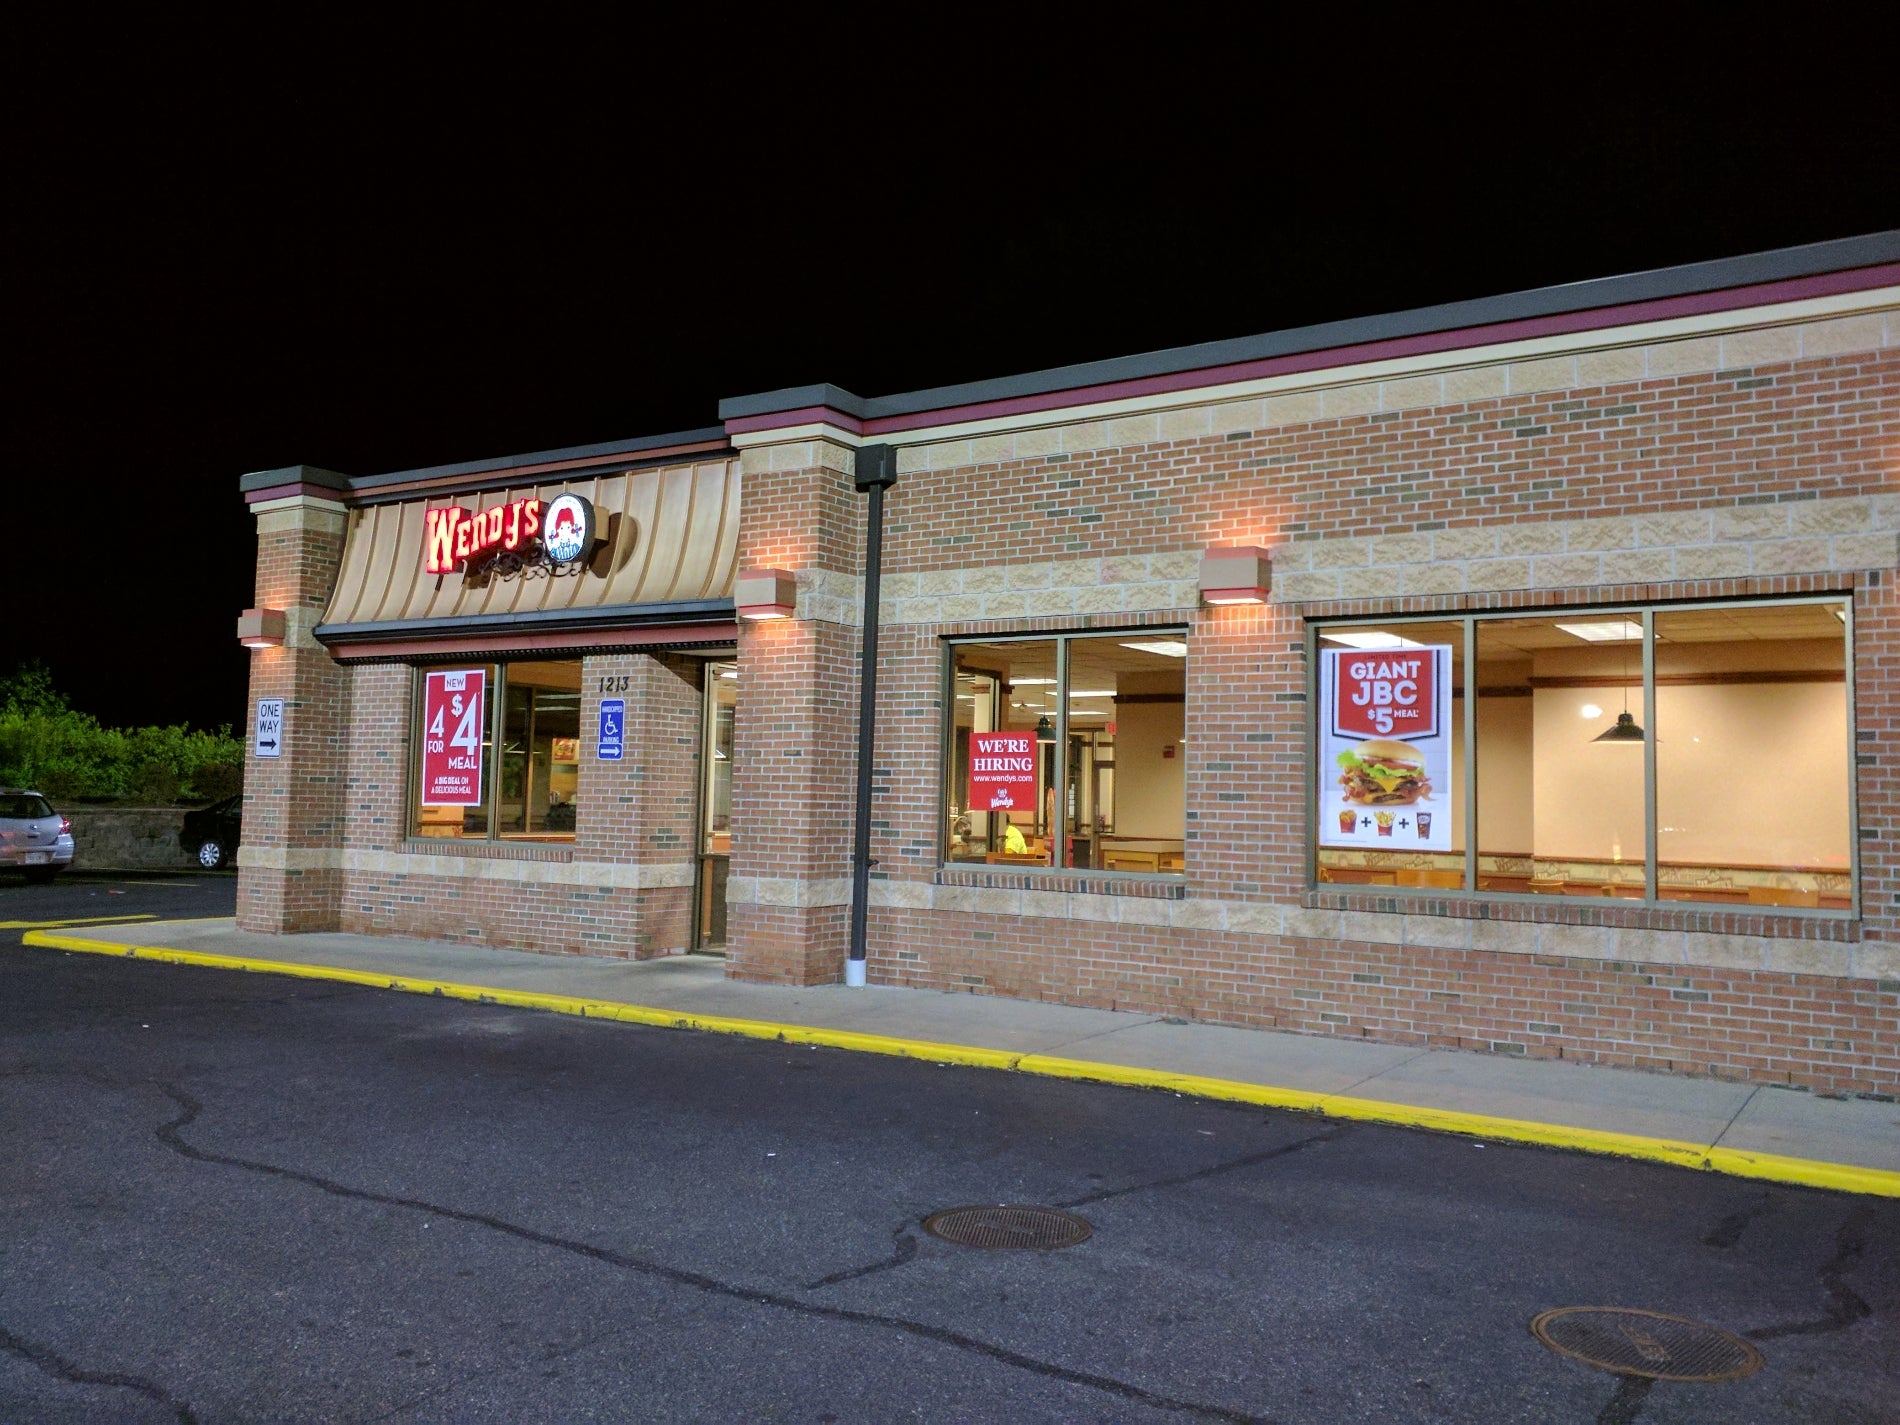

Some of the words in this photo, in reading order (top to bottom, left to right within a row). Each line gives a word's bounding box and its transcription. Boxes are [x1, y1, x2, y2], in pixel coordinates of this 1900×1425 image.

[1350, 660, 1422, 681] GIANT
[446, 678, 465, 688] NEW
[599, 676, 630, 693] 1213
[1351, 680, 1418, 706] JBC
[261, 704, 279, 717] ONE
[260, 720, 279, 733] WAY
[429, 704, 444, 738] 4
[1367, 706, 1393, 734] $5
[428, 740, 444, 753] FOR
[978, 739, 1029, 753] WE'RE
[448, 756, 477, 769] MEAL
[974, 757, 1033, 771] HIRING
[434, 777, 438, 785] A
[439, 776, 448, 785] BIG
[448, 776, 460, 785] DEAL
[974, 774, 1032, 784] www.wendys.com
[435, 785, 459, 794] DELICIOUS
[459, 785, 471, 794] MEAL
